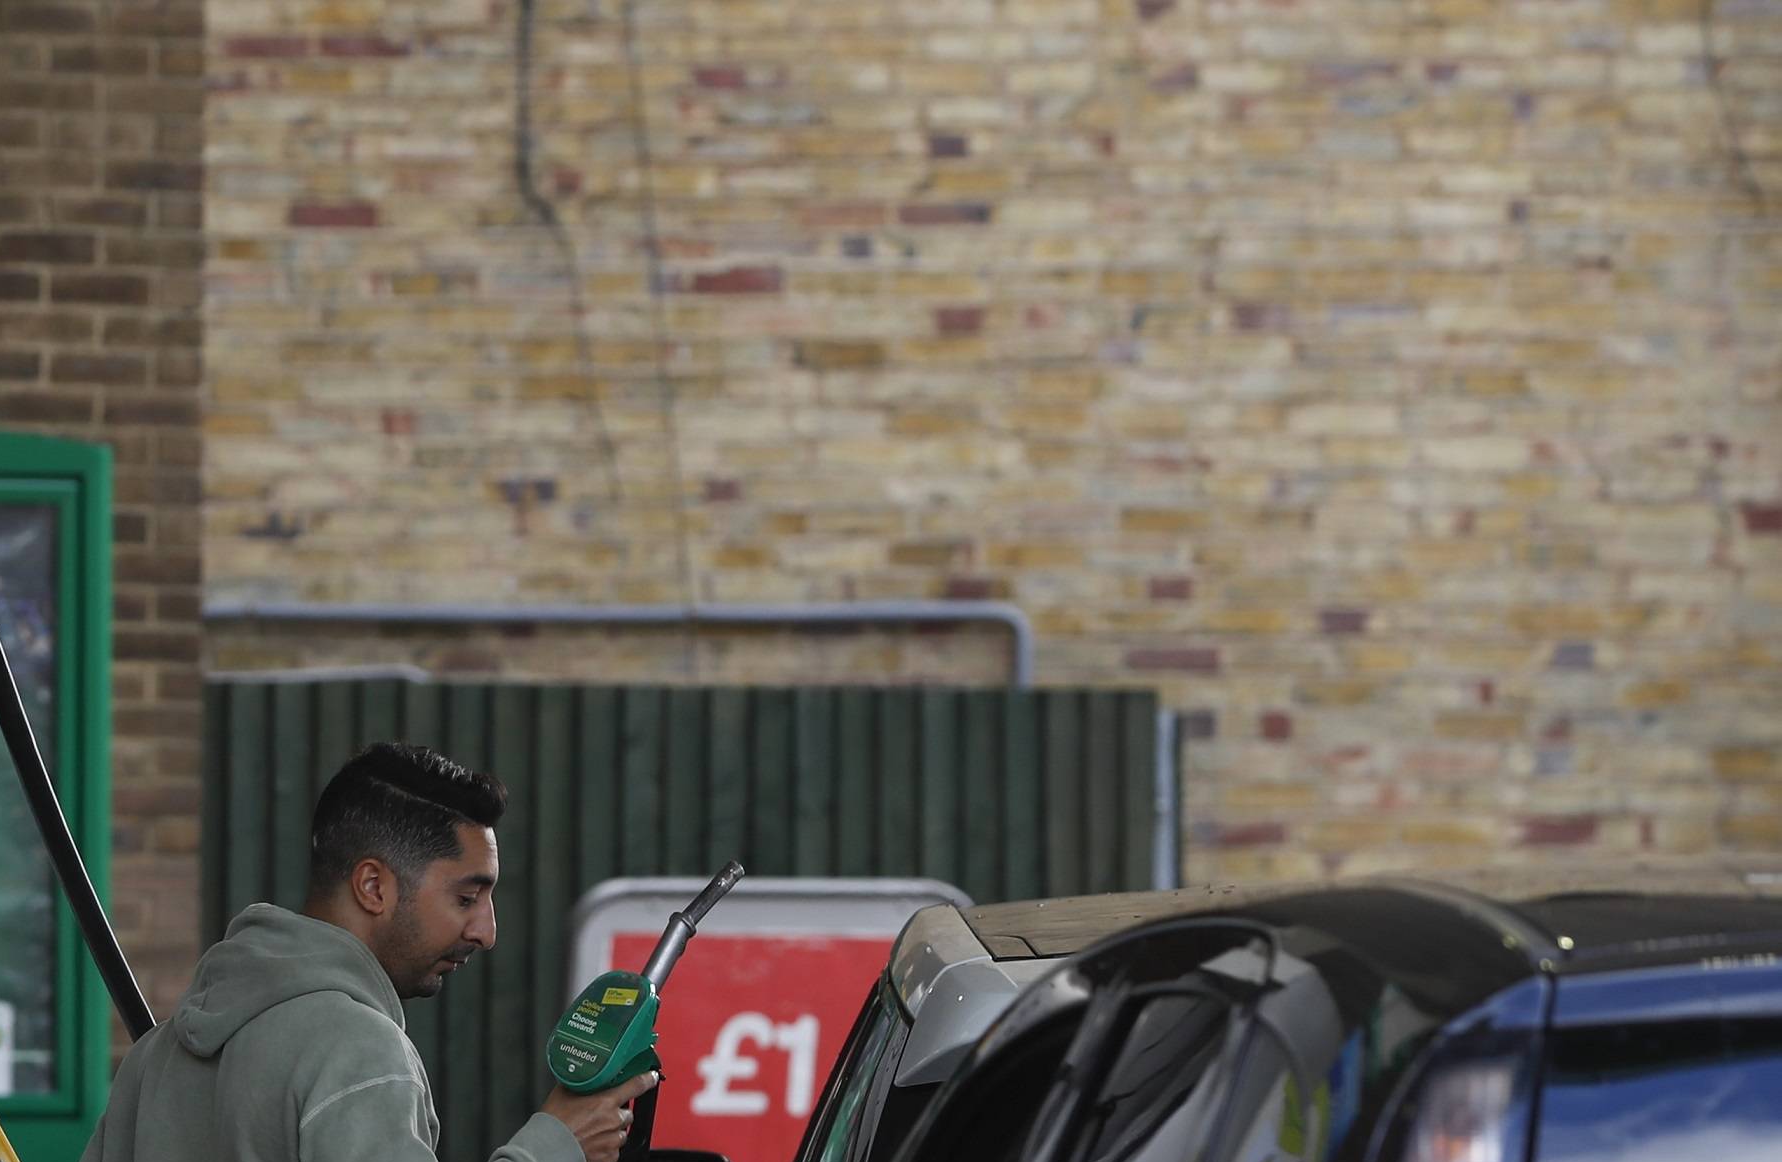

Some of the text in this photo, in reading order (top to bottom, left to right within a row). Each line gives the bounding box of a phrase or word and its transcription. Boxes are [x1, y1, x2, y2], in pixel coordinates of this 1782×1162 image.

[571, 1012, 598, 1028] Choose
[560, 1043, 598, 1063] unleaded
[691, 1012, 819, 1118] £1
